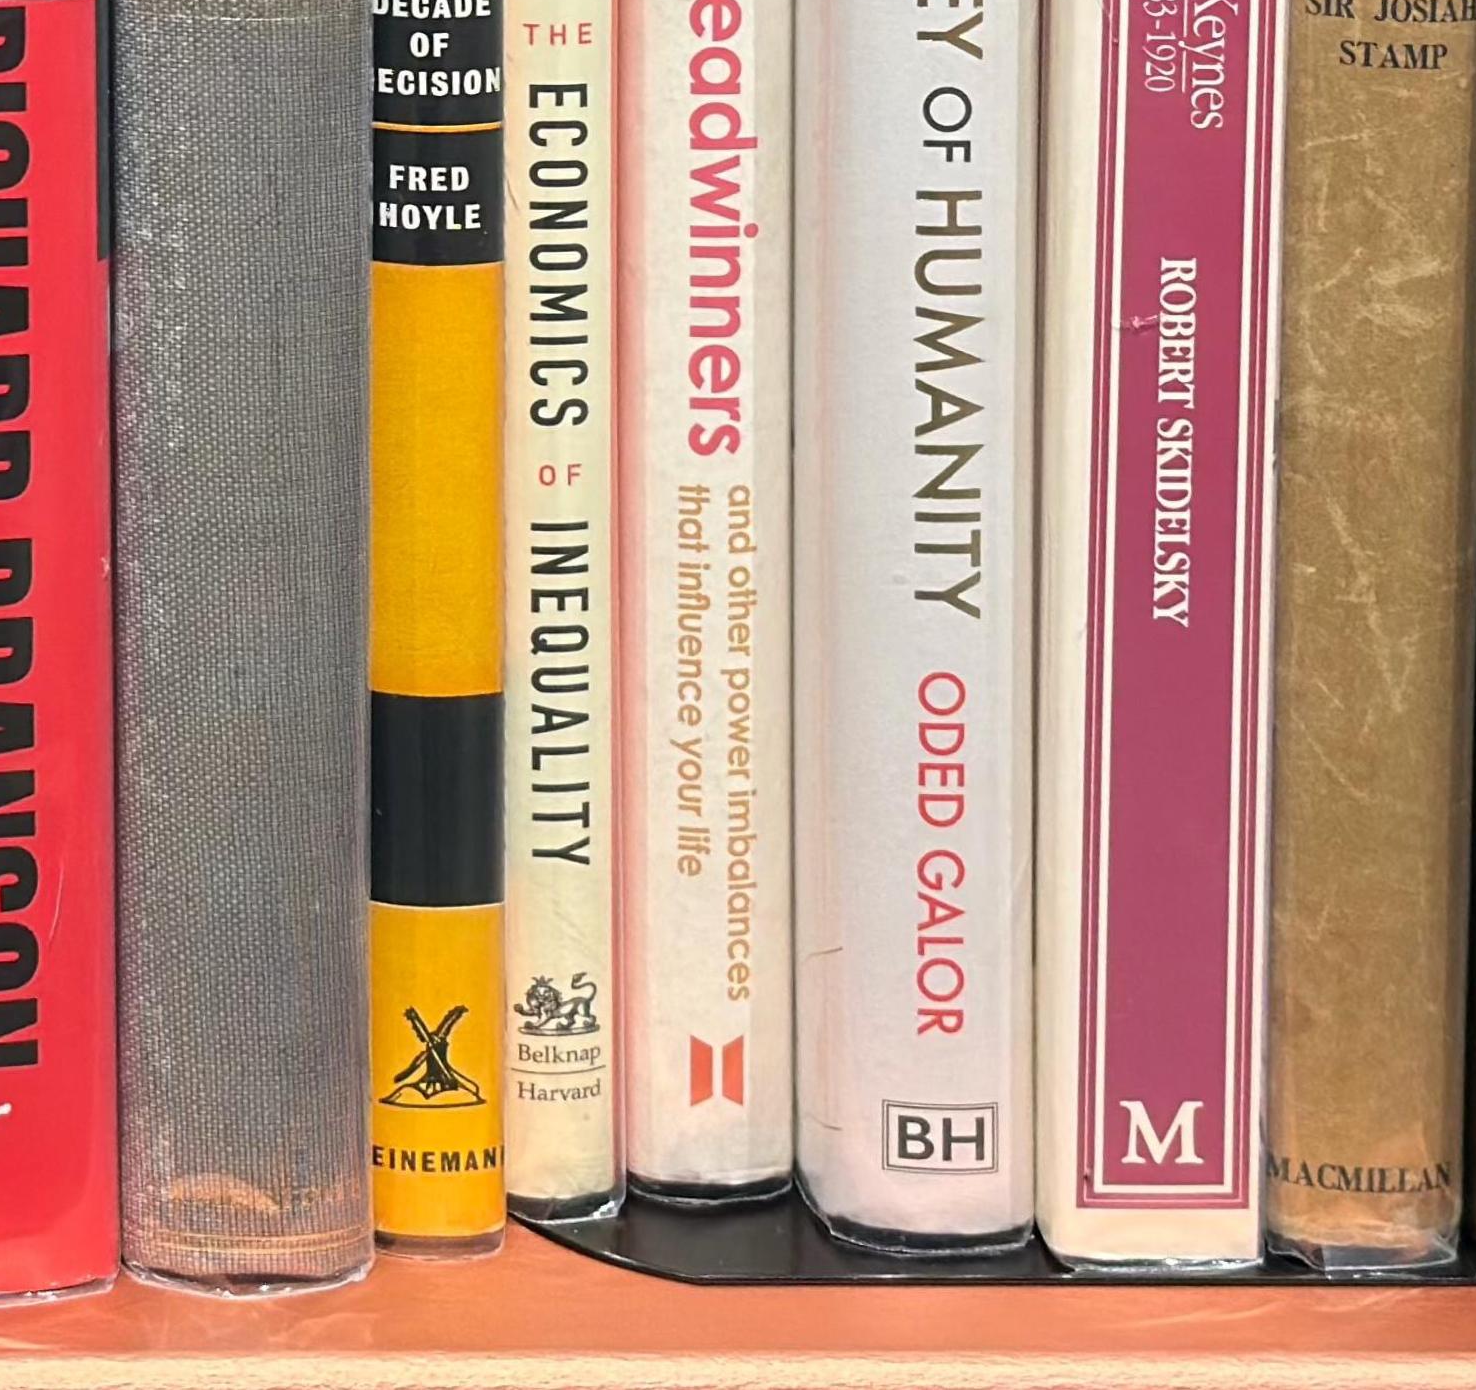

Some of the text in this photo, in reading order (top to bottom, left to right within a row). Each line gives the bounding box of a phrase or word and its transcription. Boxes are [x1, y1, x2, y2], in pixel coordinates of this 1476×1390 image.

[410, 33, 449, 57] OF
[523, 23, 593, 46] THE
[1339, 41, 1447, 70] STAMP
[922, 87, 972, 163] OF
[389, 164, 470, 192] FRED
[379, 203, 481, 230] HOYLE
[528, 83, 589, 428] ECONOMICS
[913, 190, 985, 620] HUMANITY
[1153, 257, 1197, 628] ROBERT SKIDELSKY
[538, 463, 582, 486] OF
[530, 521, 591, 866] INEQUALITY
[721, 485, 758, 1002] and other power imbalances
[916, 671, 966, 1036] ODED GALOR
[518, 1043, 601, 1064] Belknap
[518, 1080, 601, 1101] Harvard
[897, 1115, 985, 1163] BH
[1120, 1101, 1203, 1165] M
[1267, 1154, 1450, 1193] MACMILLAN
